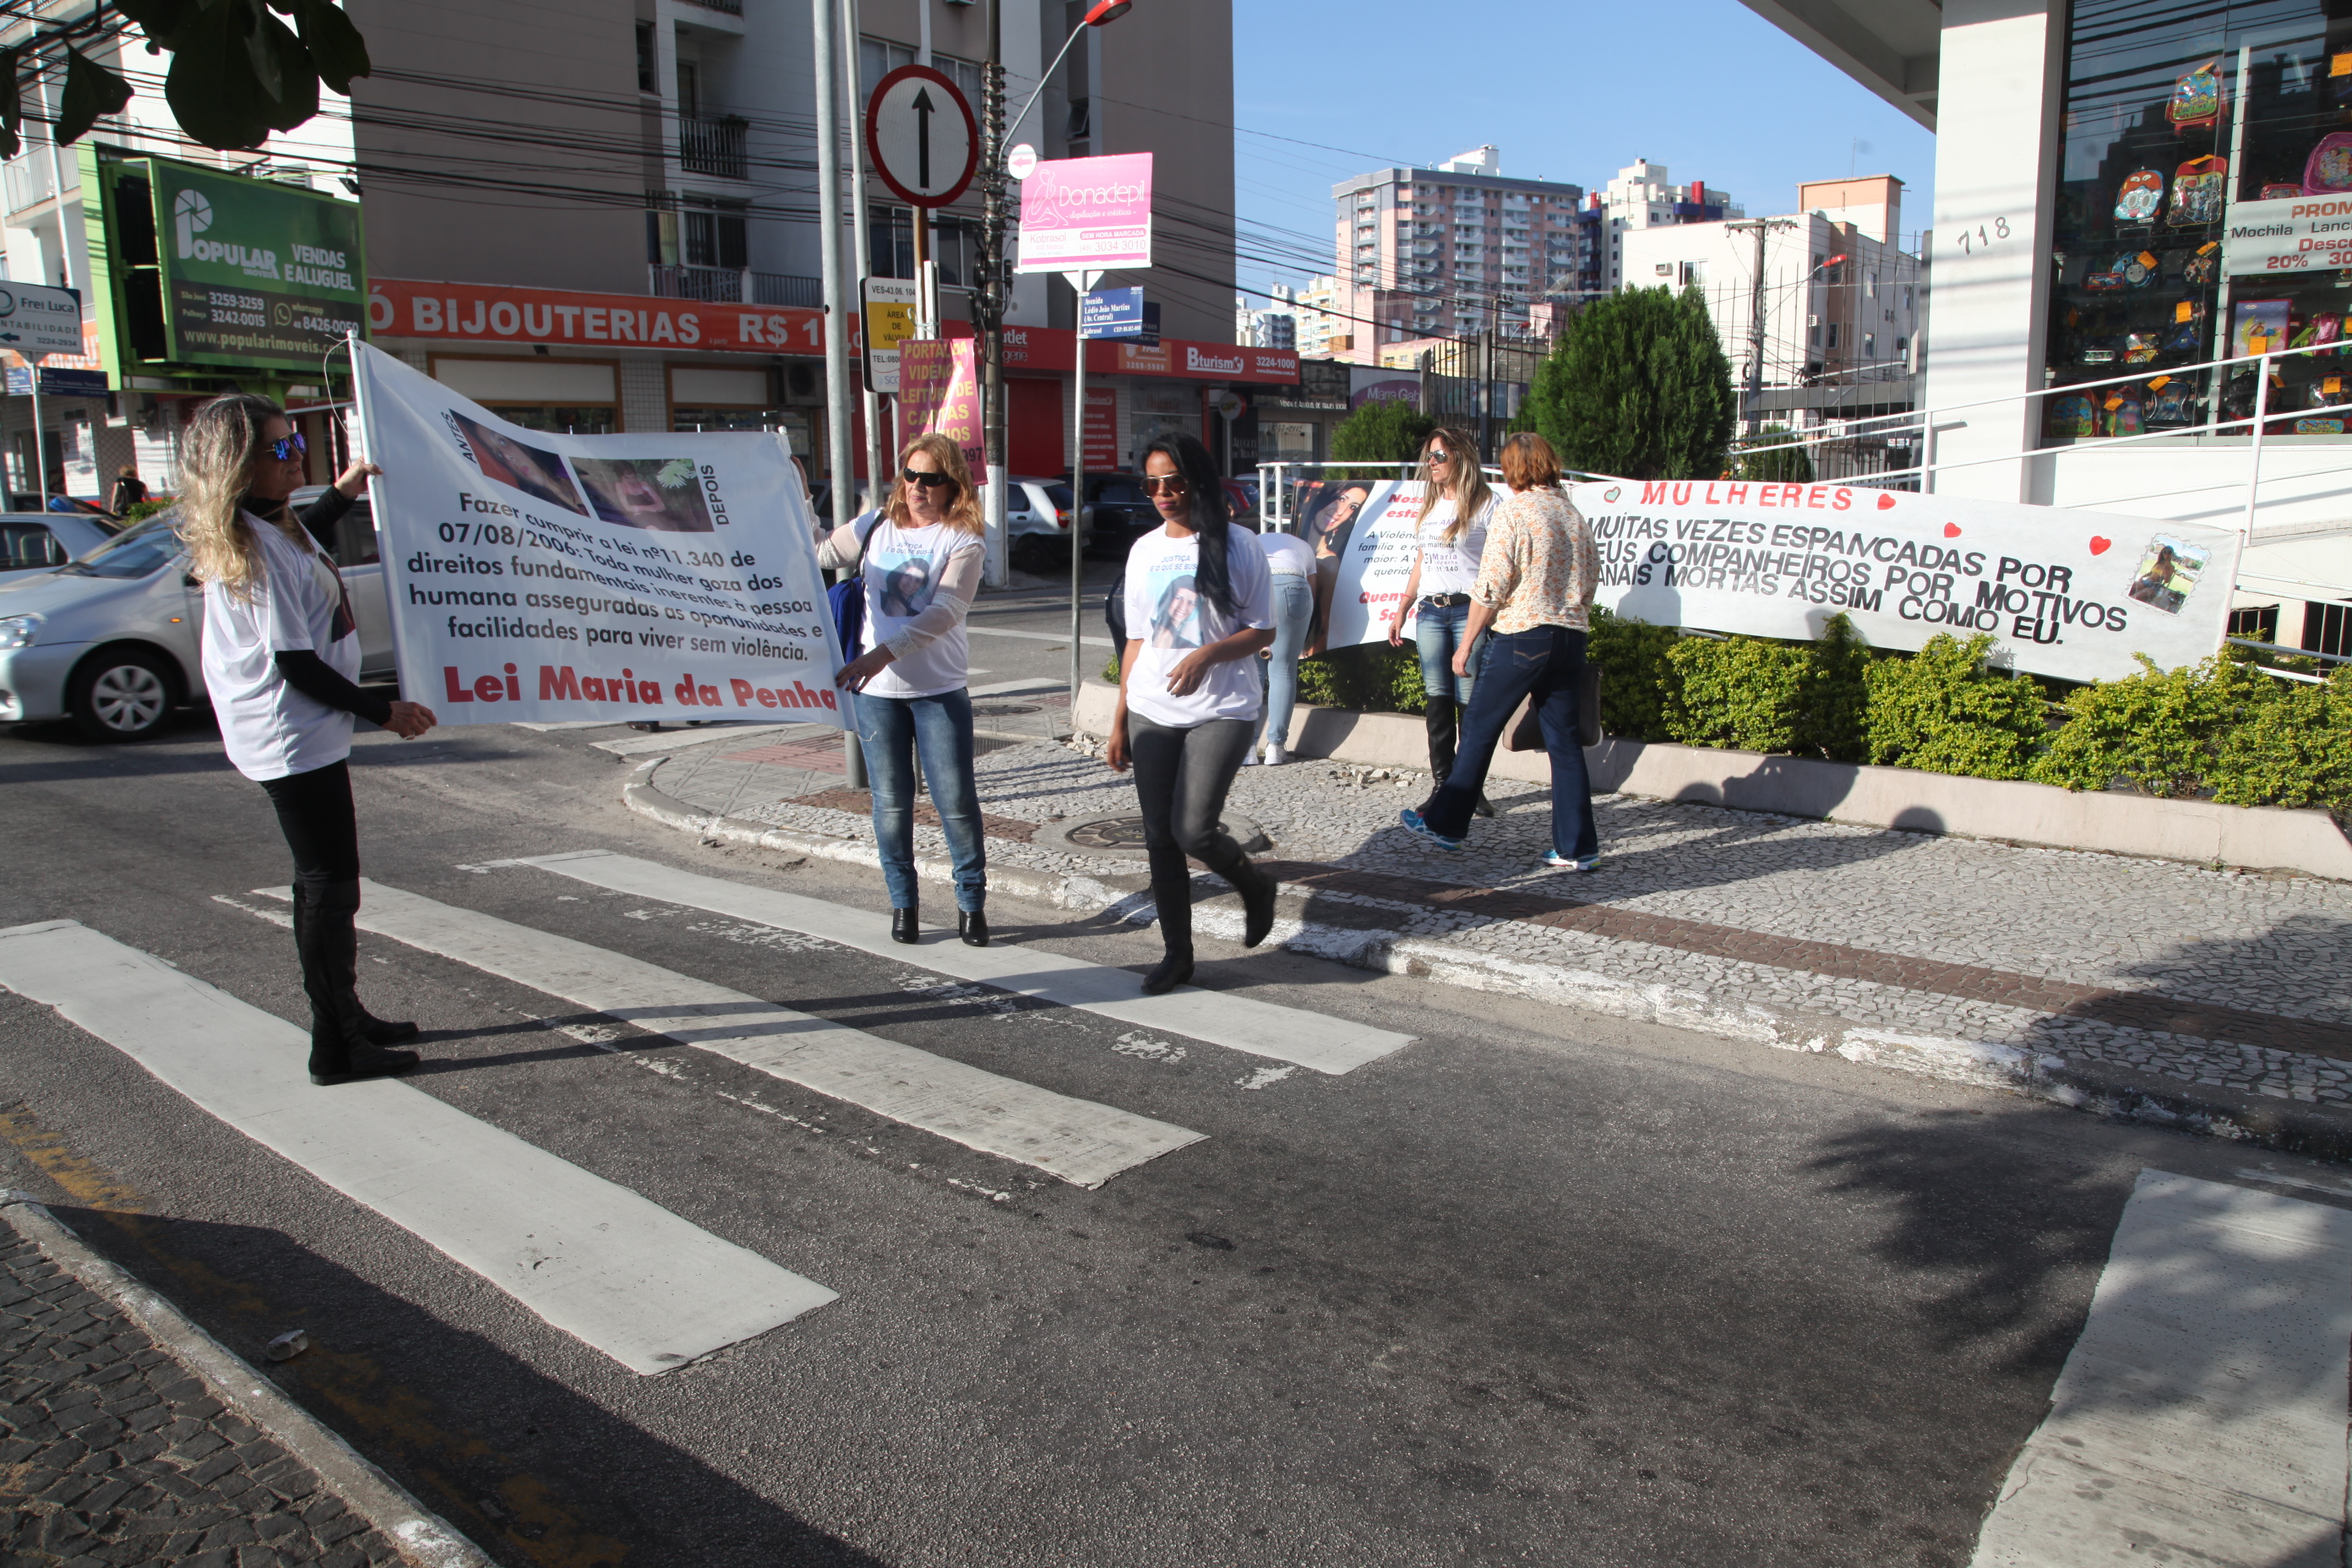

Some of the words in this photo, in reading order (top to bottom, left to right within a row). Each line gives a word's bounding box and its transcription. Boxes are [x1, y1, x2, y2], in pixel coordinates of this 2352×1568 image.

[1059, 180, 1146, 207] Donadepil
[1070, 210, 1101, 221] depilação
[174, 188, 280, 280] POPULAR
[1030, 232, 1067, 244] Kobrasol
[1081, 231, 1094, 240] SEM
[1095, 231, 1113, 239] HORA
[1113, 229, 1145, 238] MARCADA
[1957, 216, 2011, 256] 718
[2231, 224, 2294, 239] Mochila
[1080, 243, 1092, 253] (48)
[1095, 241, 1119, 253] 3034
[1122, 239, 1146, 252] 3010
[291, 243, 346, 270] VENDAS
[2267, 254, 2309, 270] 20%
[21, 297, 45, 310] Frei
[48, 301, 75, 313] Luca
[209, 291, 264, 311] 3259-3259
[1084, 297, 1103, 306] Avenida
[1084, 306, 1098, 315] Lédio
[1099, 305, 1110, 313] João
[1110, 303, 1130, 313] Martins
[291, 302, 324, 317] whatsapp
[887, 309, 905, 318] ÁREA
[211, 309, 266, 328] 3242-0015
[411, 296, 700, 345] BIJOUTERIAS
[738, 313, 789, 348] R$
[1093, 313, 1113, 323] Central)
[0, 320, 79, 335] NTABILIDADE
[36, 337, 77, 347] 3224-2934
[184, 330, 350, 356] www.popularimoveis.com.
[904, 343, 950, 359] PORTAL
[952, 340, 968, 356] DA
[1002, 350, 1028, 363] gerie
[1255, 356, 1295, 370] 3224-1000
[1126, 362, 1165, 371] 3259-5989
[956, 380, 974, 398] DE
[1397, 388, 1420, 402] Gab
[440, 411, 477, 464] ANTES
[700, 464, 730, 525] DEPOIS
[1387, 494, 1424, 504] Noss
[460, 492, 520, 519] Fazer
[525, 513, 594, 544] cumprir
[599, 537, 612, 549] a
[612, 537, 638, 557] lei
[731, 550, 756, 568] de
[1367, 531, 1375, 539] A
[1380, 531, 1418, 540] Violênc
[1358, 542, 1394, 552] família
[438, 522, 583, 558] 07/08/2006:
[584, 547, 629, 573] Toda
[633, 564, 694, 585] mulher
[700, 577, 743, 591] goza
[748, 574, 783, 591] dos
[1364, 555, 1398, 564] maior:
[1676, 519, 1767, 545] VEZES
[1770, 524, 1987, 577] ESPANCADAS
[1995, 556, 2073, 594] POR
[407, 551, 504, 574] direitos
[510, 555, 651, 594] fundamentais
[653, 581, 732, 610] inerentes
[735, 598, 748, 612] à
[749, 600, 813, 617] pessoa
[1598, 540, 1637, 565] EUS
[1884, 565, 1955, 602] POR
[1975, 580, 2127, 632] MOTIVOS
[409, 583, 518, 607] humana
[525, 591, 659, 618] asseguradas
[664, 607, 686, 621] as
[690, 610, 808, 638] oportunidades
[811, 623, 823, 638] e
[1663, 564, 1779, 596] MORTAS
[1787, 577, 1883, 612] ASSIM
[1898, 595, 2000, 632] COMO
[2012, 615, 2064, 645] EU.
[448, 615, 579, 640] facilidades
[585, 627, 633, 646] para
[638, 626, 685, 649] viver
[690, 636, 727, 653] sem
[731, 636, 808, 662] violência.
[444, 662, 521, 703] Lei
[539, 666, 664, 705] Maria
[674, 672, 724, 706] da
[729, 678, 838, 711] Penha
